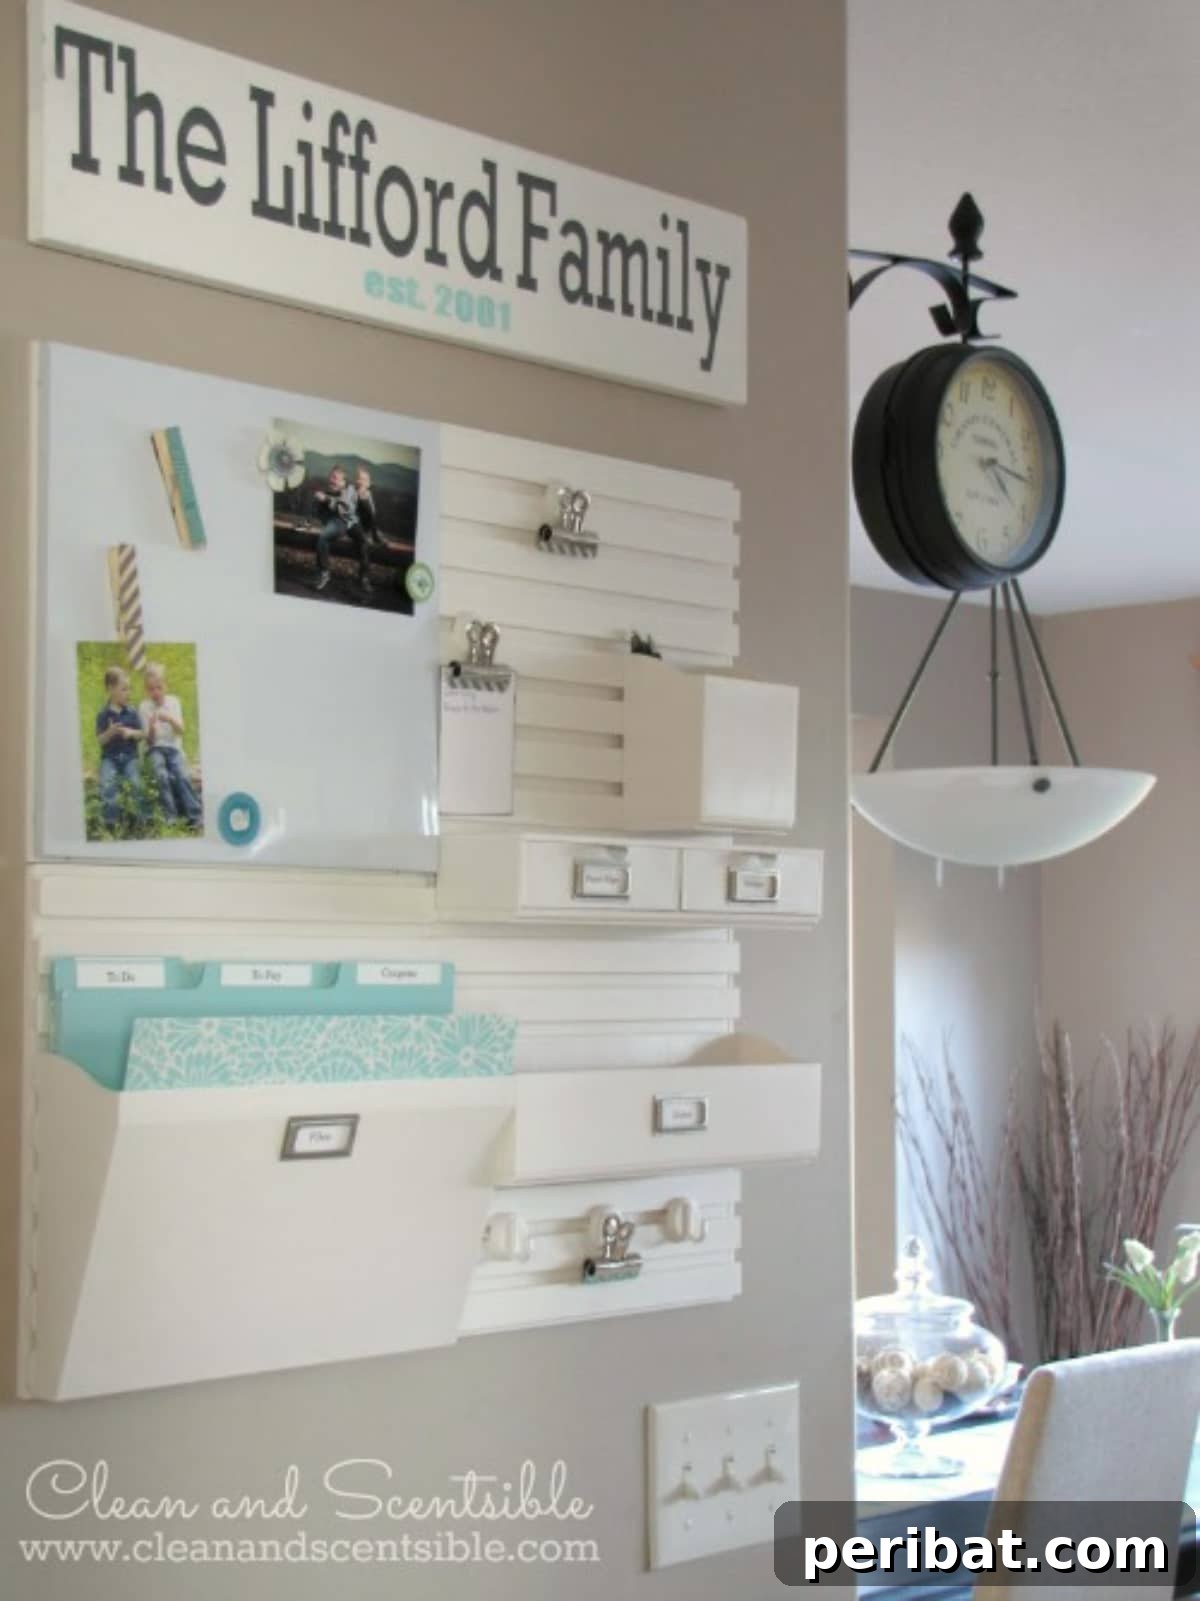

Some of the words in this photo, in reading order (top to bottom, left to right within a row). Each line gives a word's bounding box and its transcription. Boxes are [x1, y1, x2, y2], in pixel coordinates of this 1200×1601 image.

[55, 26, 226, 206] The
[250, 86, 502, 282] Lifford
[517, 172, 731, 372] Family
[363, 266, 426, 313] est.
[434, 282, 512, 334] 2001
